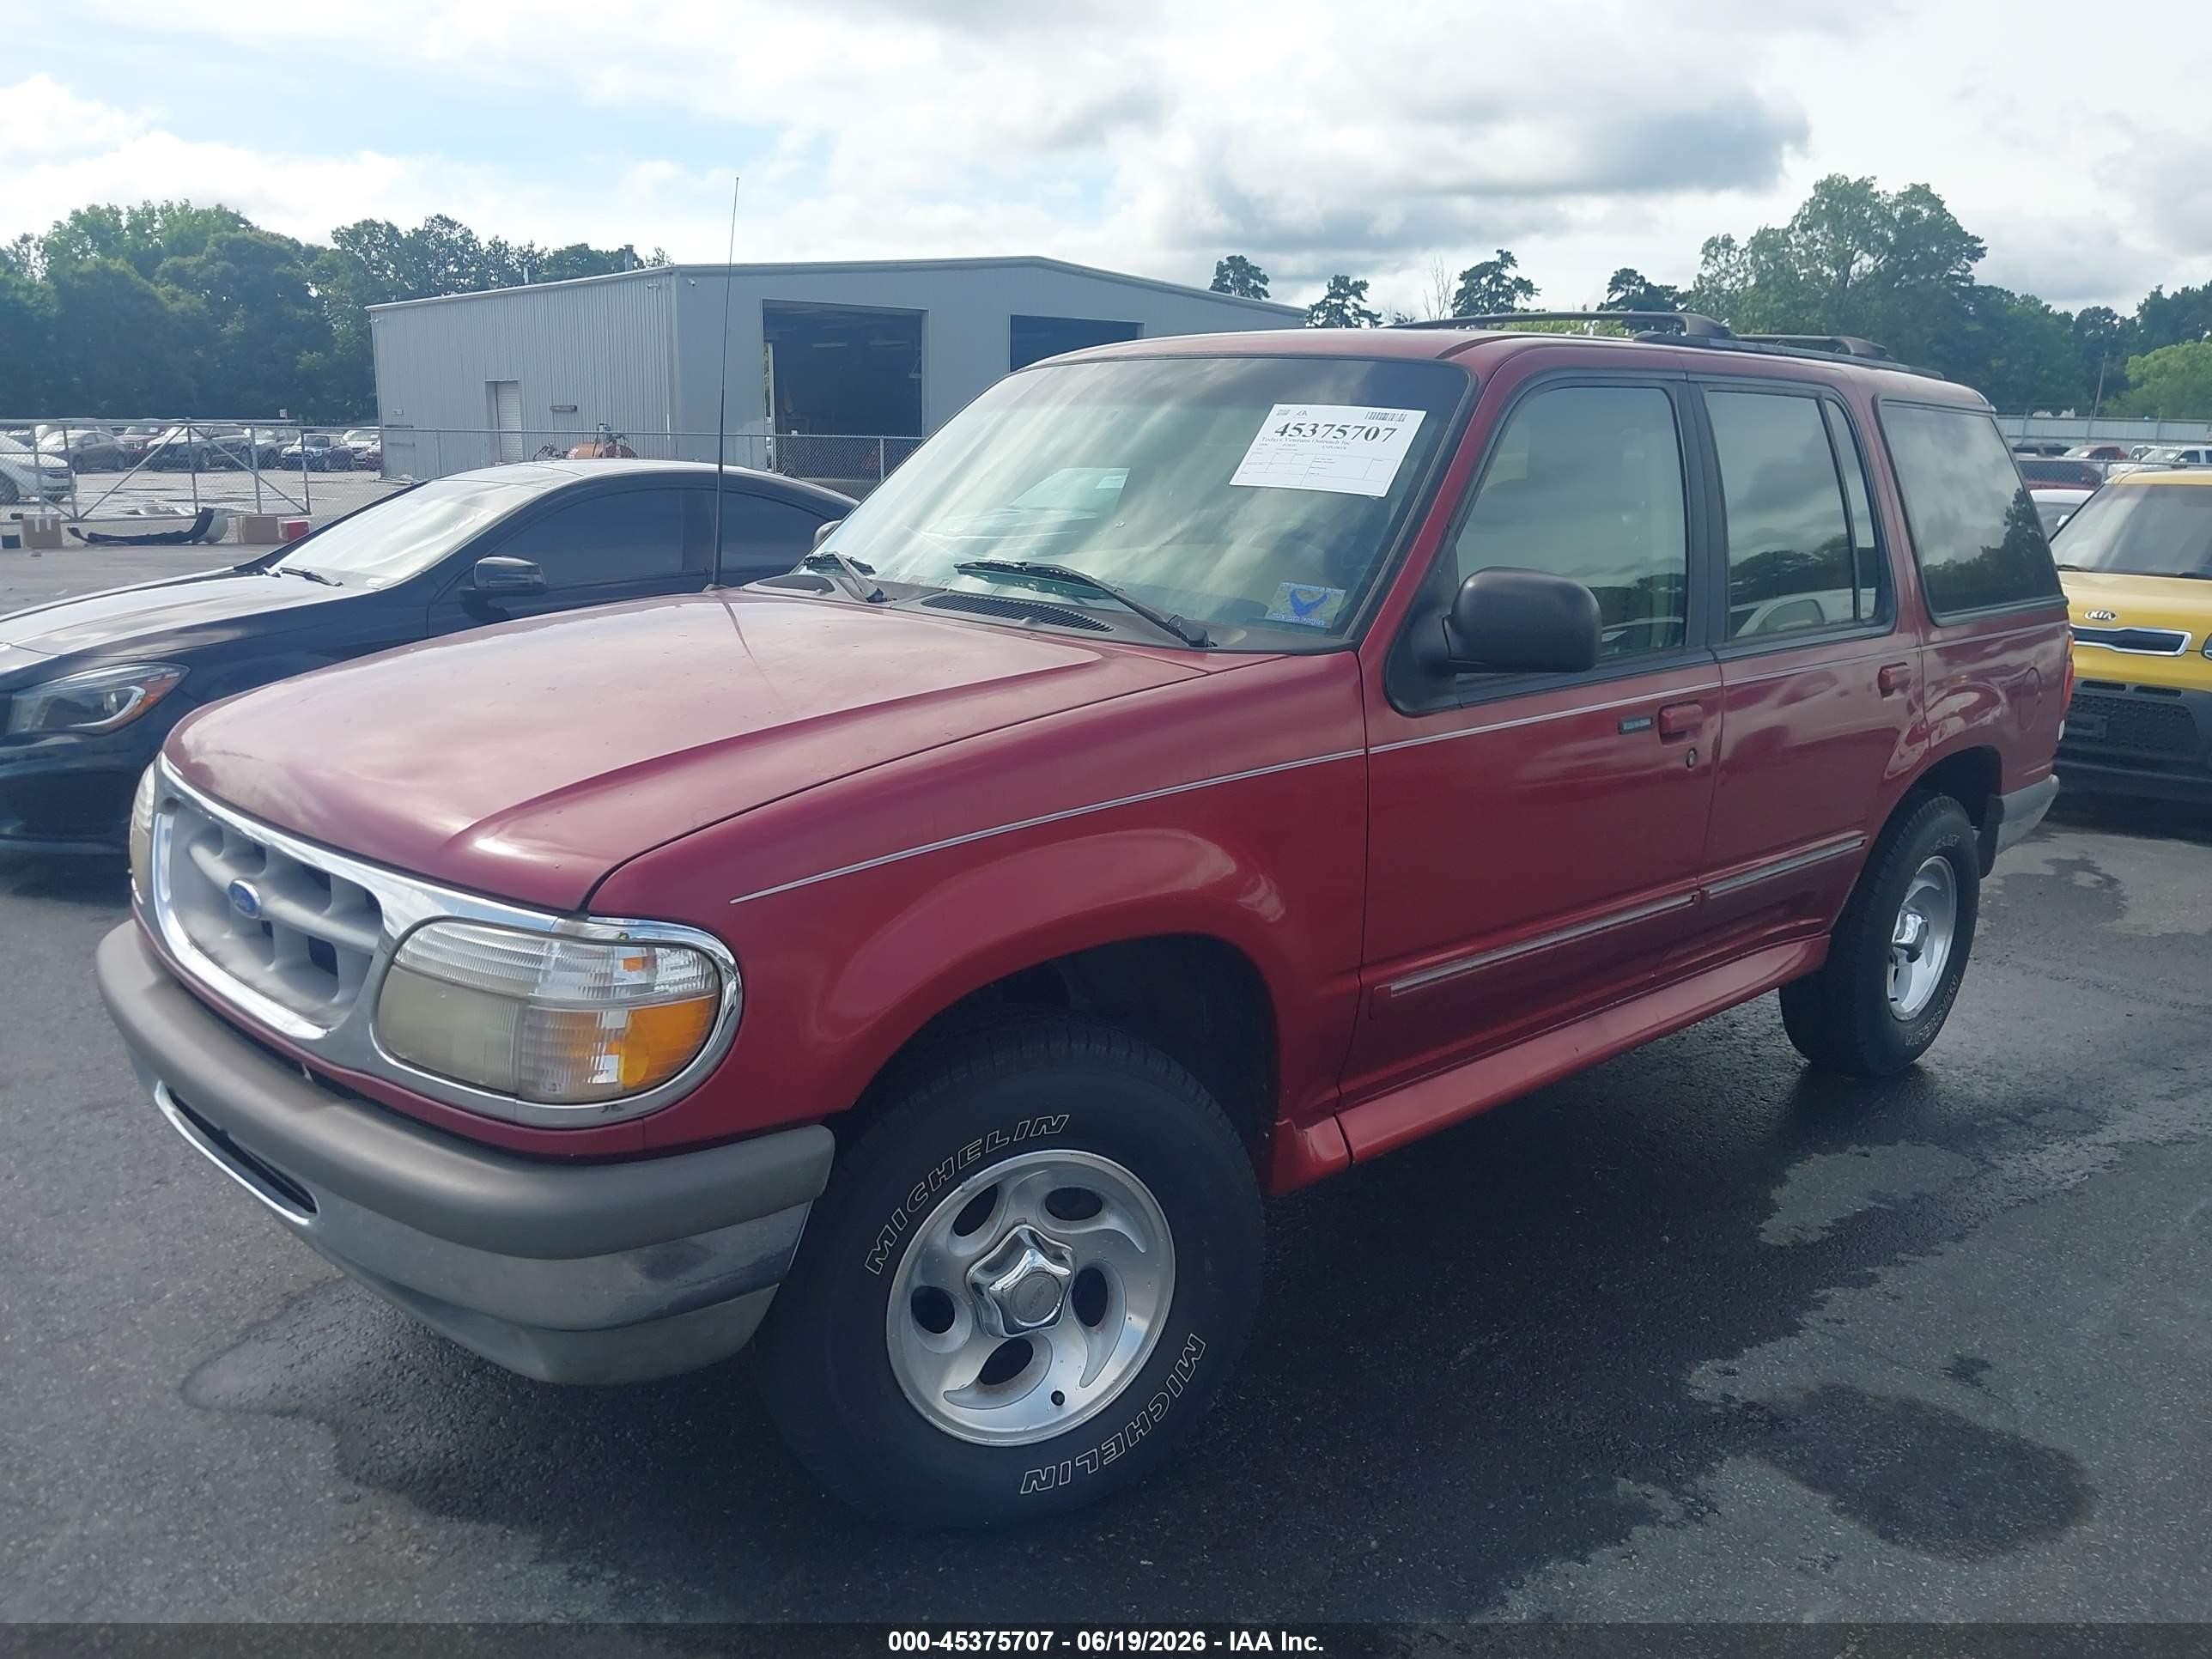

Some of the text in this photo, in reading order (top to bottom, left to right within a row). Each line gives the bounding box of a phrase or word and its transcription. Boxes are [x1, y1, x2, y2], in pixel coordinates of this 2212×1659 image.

[1274, 422, 1398, 443] 45375707
[2088, 611, 2113, 620] KIA
[865, 1115, 1070, 1275] MICHELIN
[1020, 1333, 1206, 1494] MICHELIN
